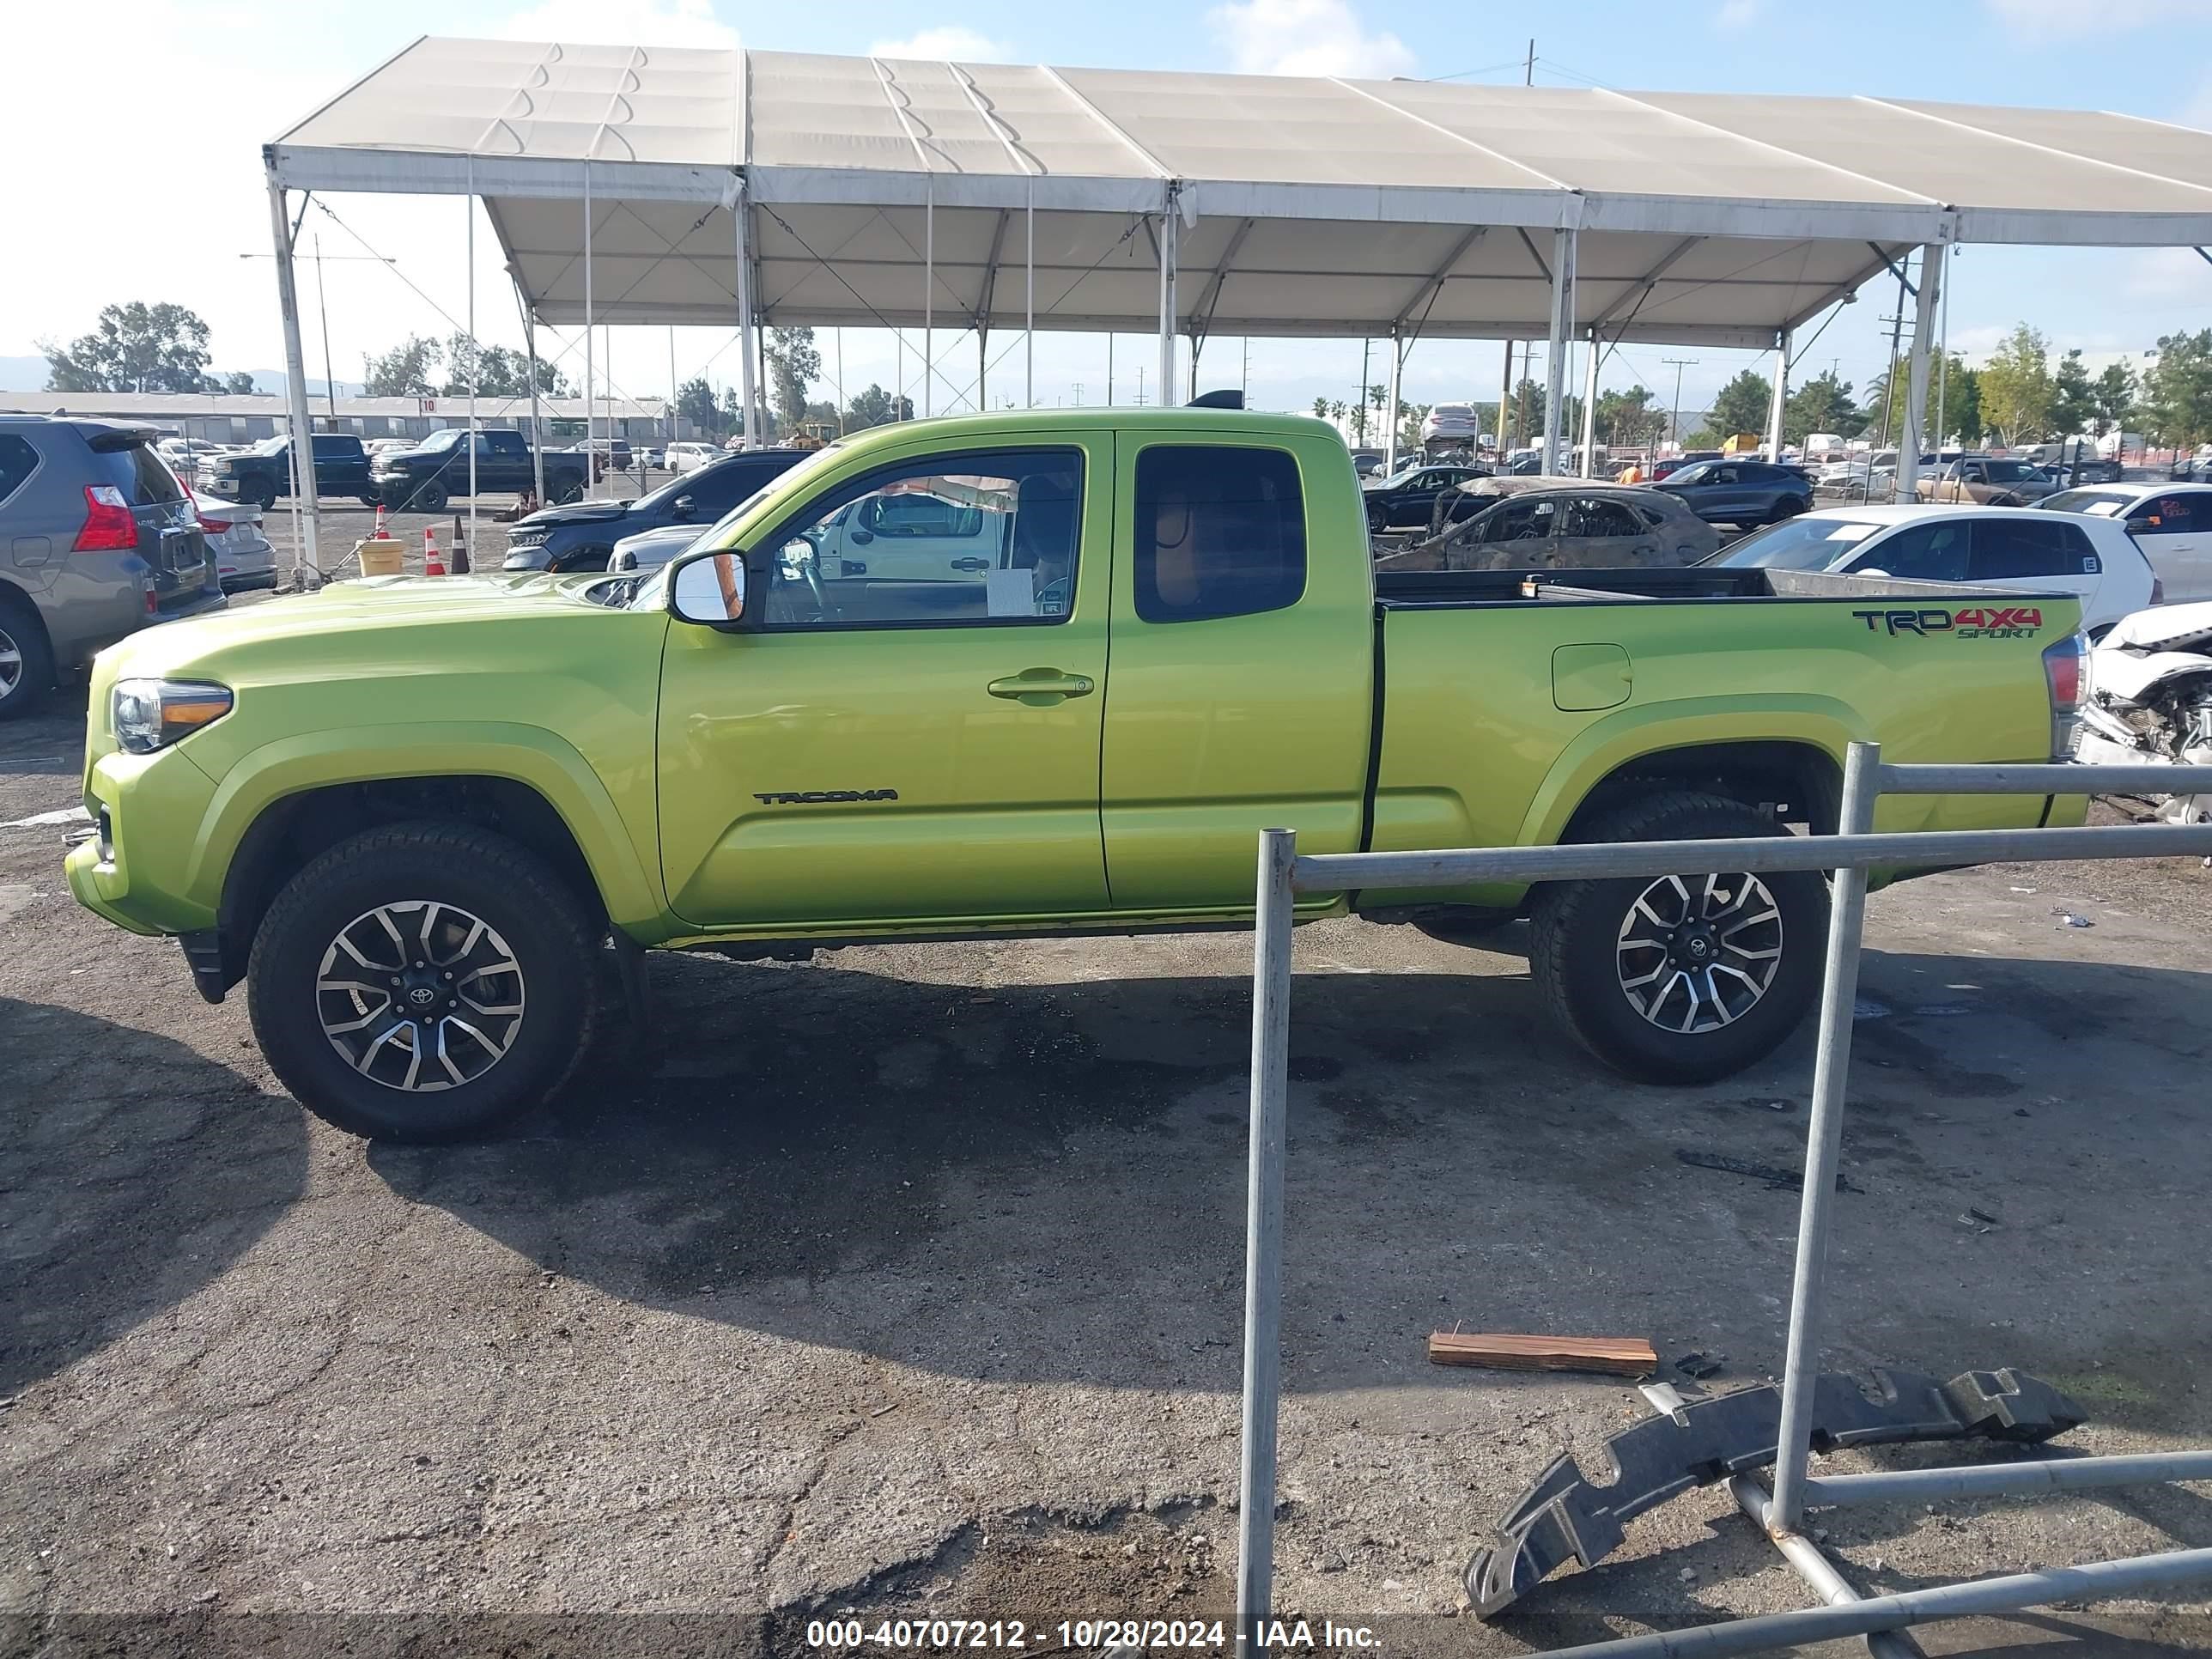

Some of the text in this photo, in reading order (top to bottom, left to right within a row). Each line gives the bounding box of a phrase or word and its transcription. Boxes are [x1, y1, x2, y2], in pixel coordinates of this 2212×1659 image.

[424, 399, 434, 411] 10
[1852, 609, 1954, 638] TRD
[1957, 628, 2040, 639] SPORT
[752, 789, 898, 805] TACOMA
